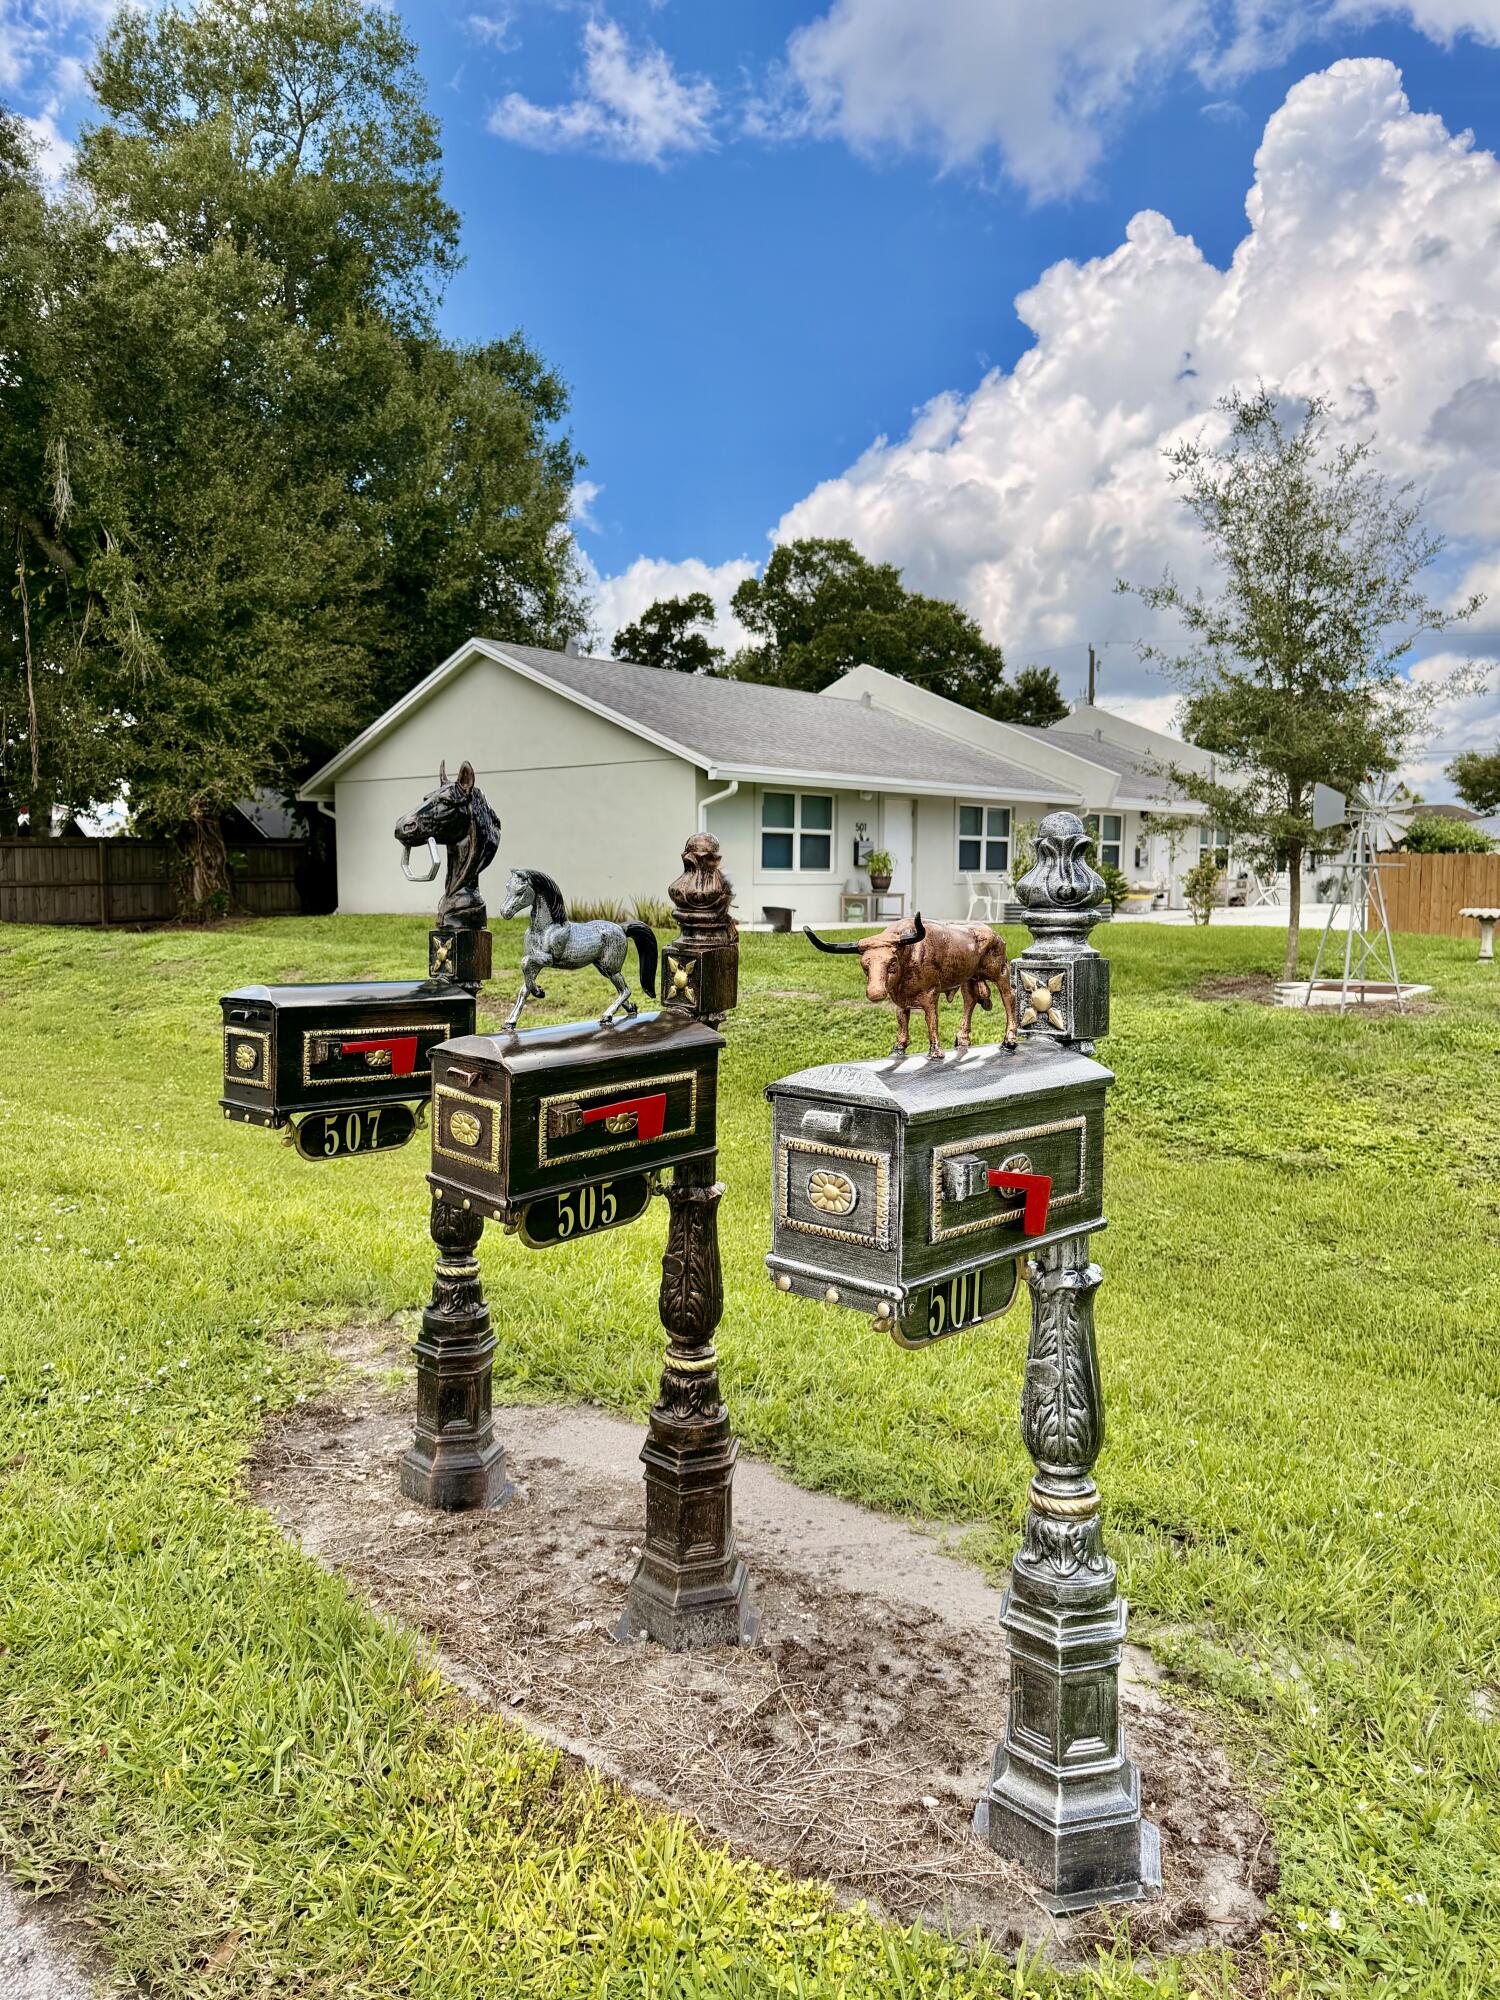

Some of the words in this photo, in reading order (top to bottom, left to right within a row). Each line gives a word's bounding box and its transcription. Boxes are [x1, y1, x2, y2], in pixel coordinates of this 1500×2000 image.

[855, 822, 867, 833] 501
[324, 1110, 382, 1155] 507
[558, 1182, 617, 1237] 505
[929, 1270, 982, 1336] 501
